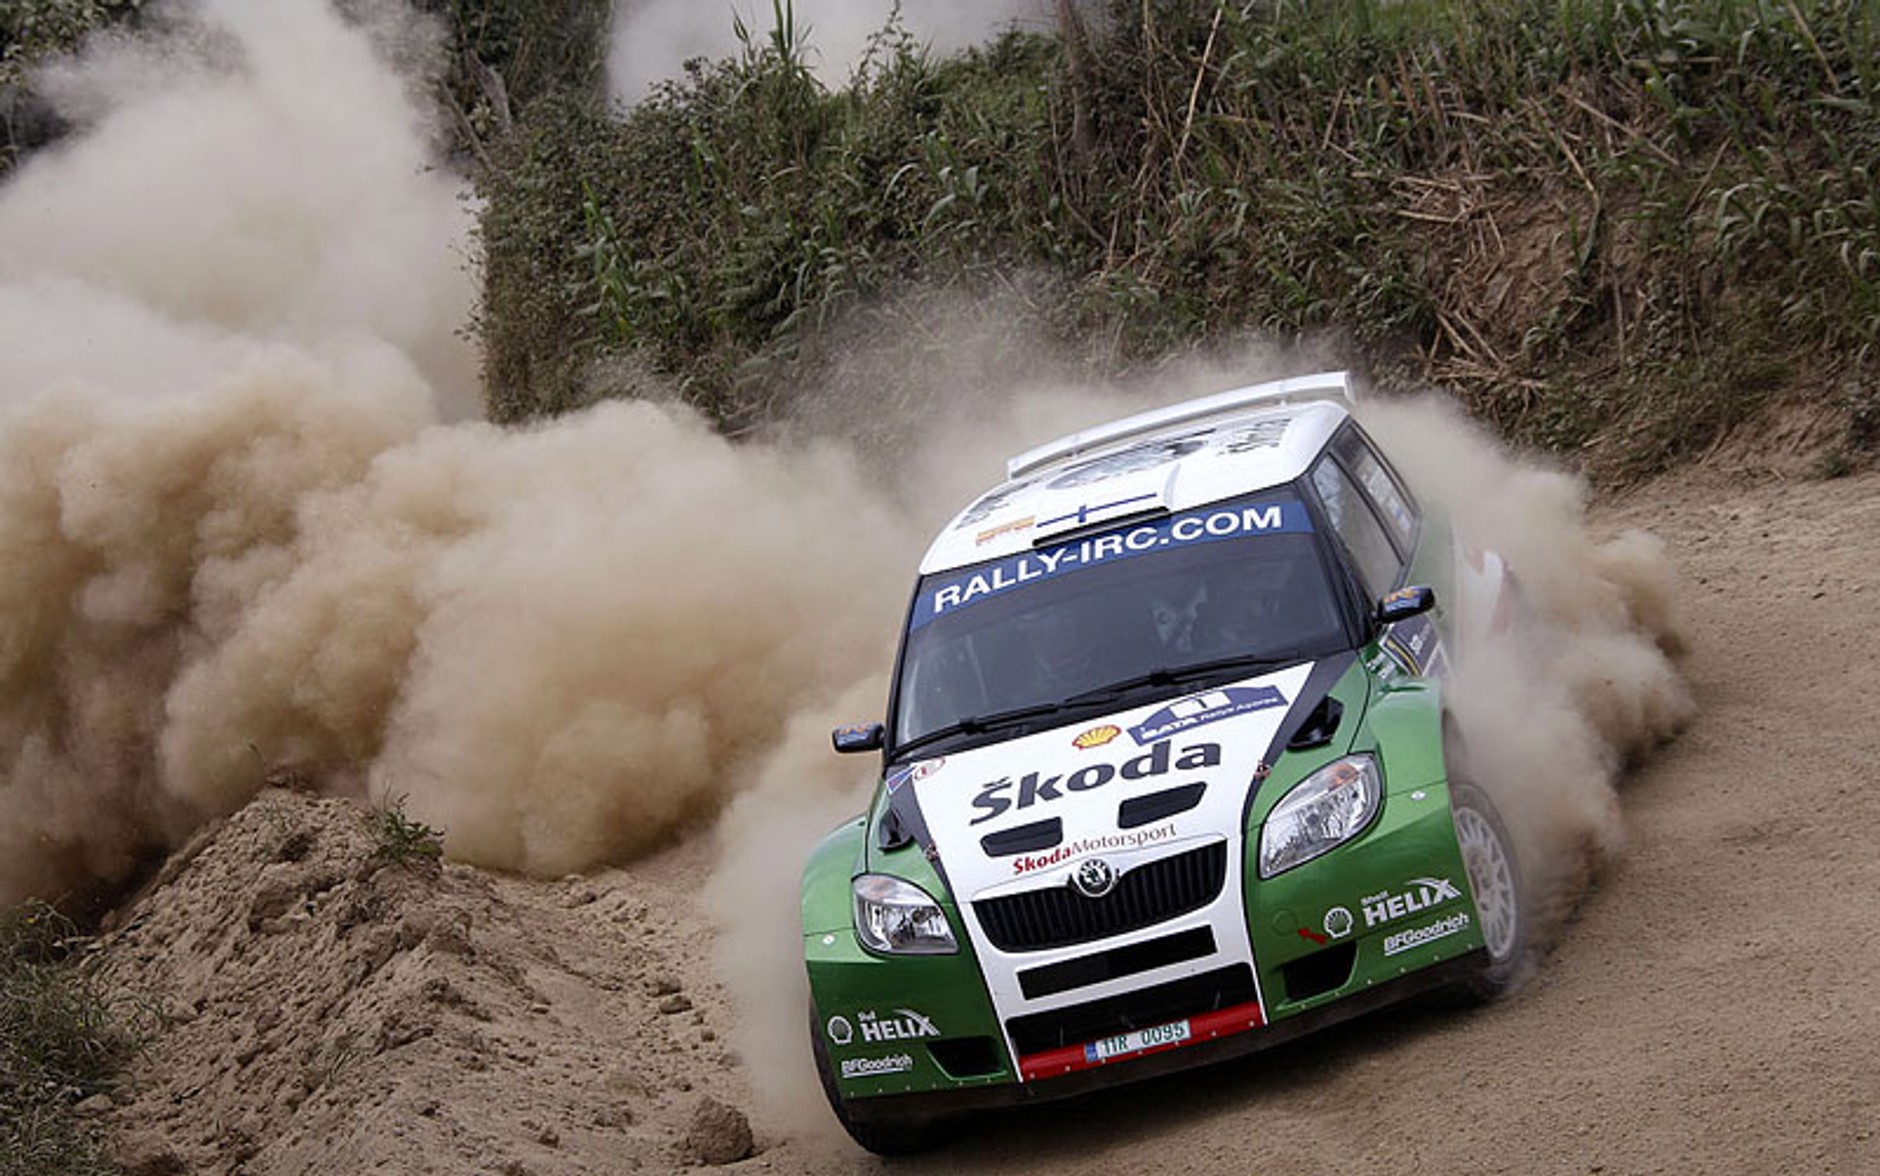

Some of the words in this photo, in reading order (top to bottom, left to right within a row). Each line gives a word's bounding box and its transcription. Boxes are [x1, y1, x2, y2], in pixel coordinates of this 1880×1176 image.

[933, 506, 1283, 613] RALLY-IRC.COM
[968, 739, 1222, 826] Škoda
[1362, 878, 1461, 928] HELIX
[1384, 912, 1470, 954] BFGoodrich
[860, 1011, 941, 1042] HELIX
[1141, 1023, 1186, 1046] 0095
[841, 1053, 913, 1076] BFGoodrich
